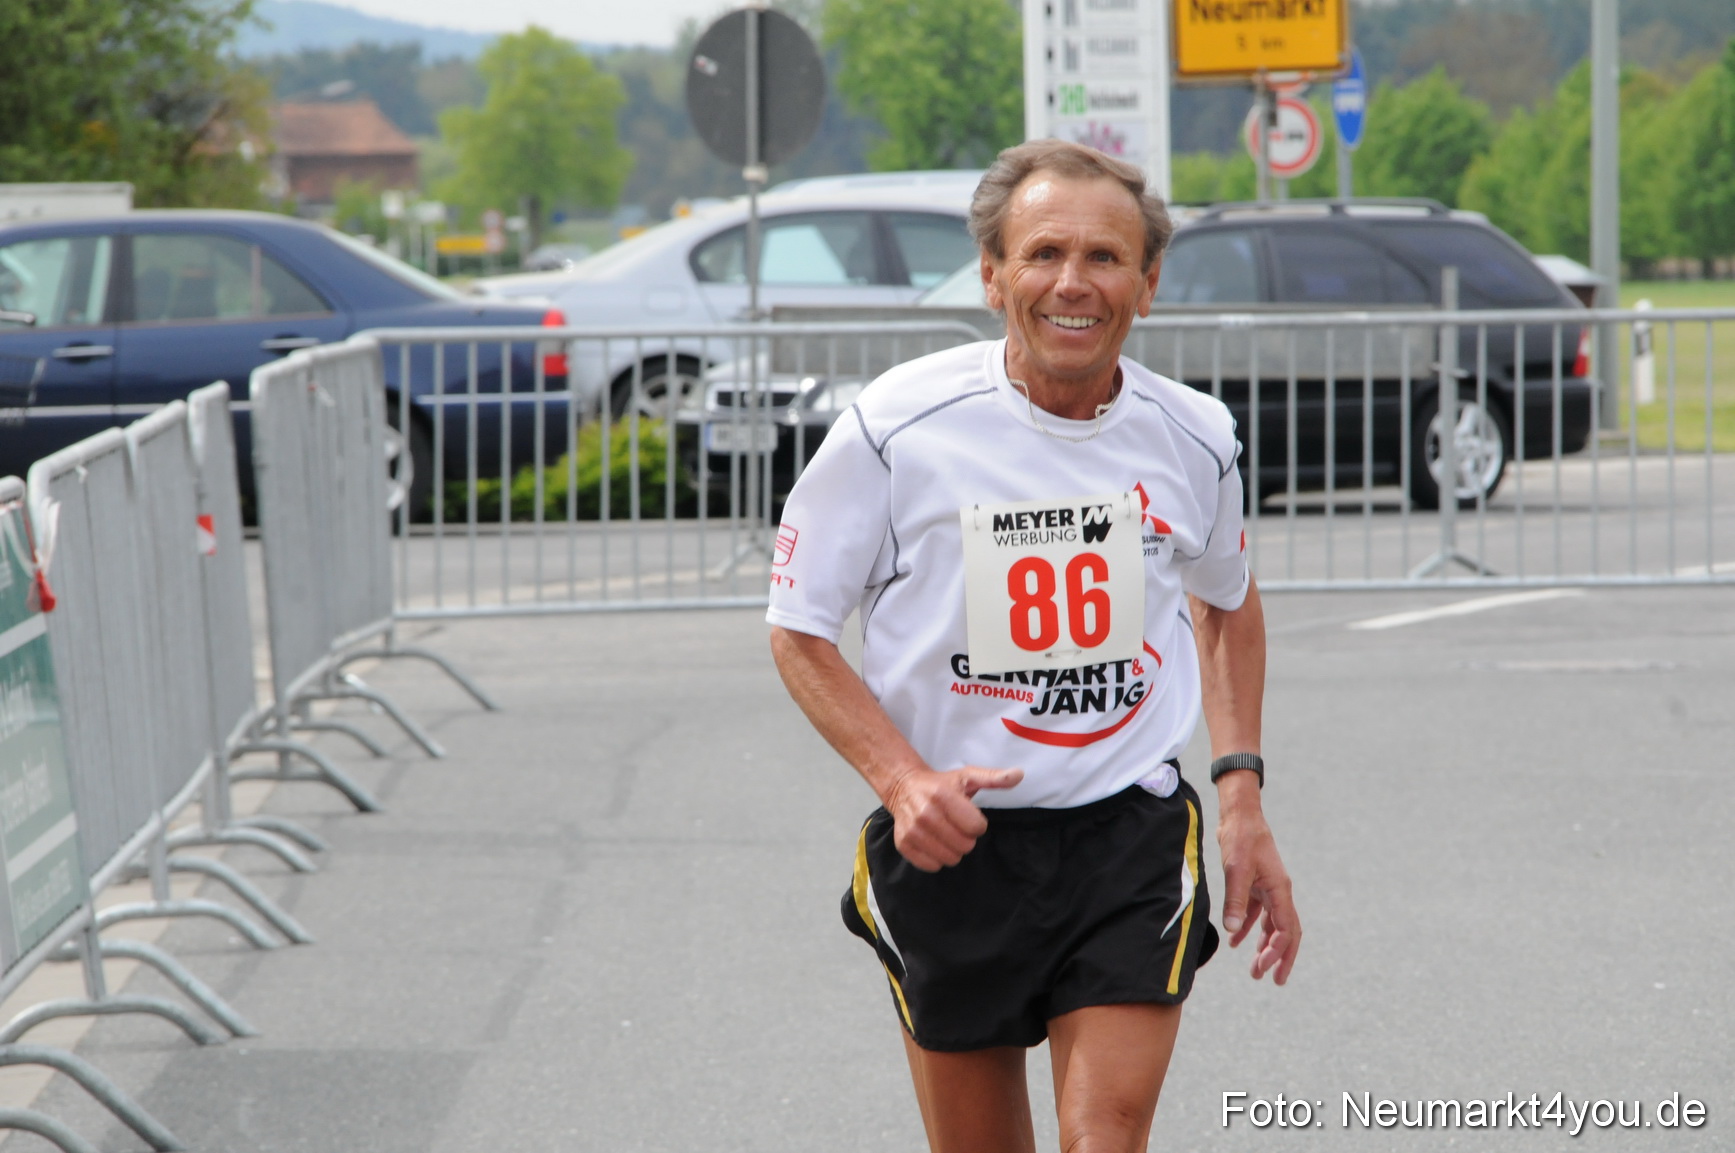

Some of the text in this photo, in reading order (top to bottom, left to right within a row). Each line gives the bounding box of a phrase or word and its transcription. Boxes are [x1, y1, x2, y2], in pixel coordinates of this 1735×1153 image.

[1189, 0, 1327, 23] Neumarkt
[993, 508, 1076, 533] MEYER
[993, 527, 1078, 547] WERBUNG
[1007, 552, 1111, 652] 86
[951, 681, 1035, 704] AUTOHAUS
